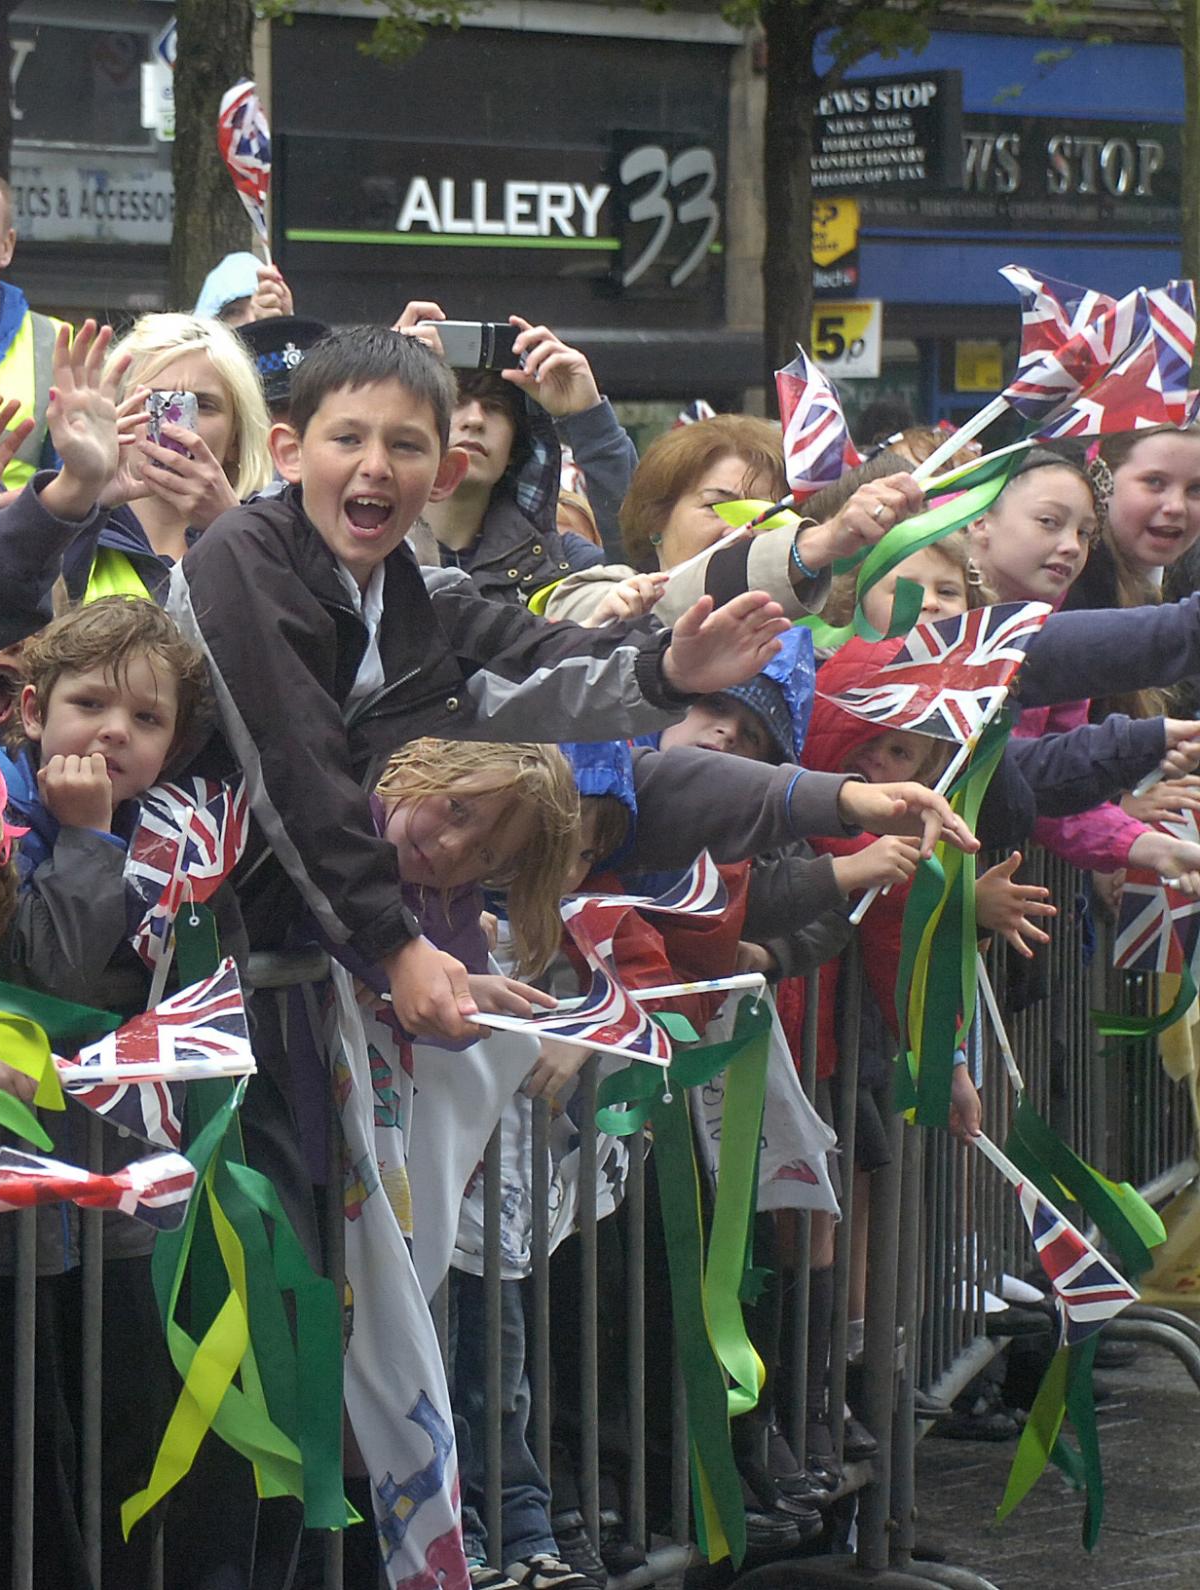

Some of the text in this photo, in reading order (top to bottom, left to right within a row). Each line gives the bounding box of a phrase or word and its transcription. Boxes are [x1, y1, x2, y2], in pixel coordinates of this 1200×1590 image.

[814, 81, 937, 115] EWS STOP
[1047, 135, 1164, 196] STOP
[56, 188, 71, 218] &
[396, 146, 720, 287] ALLERY 33
[814, 317, 865, 363] 5p
